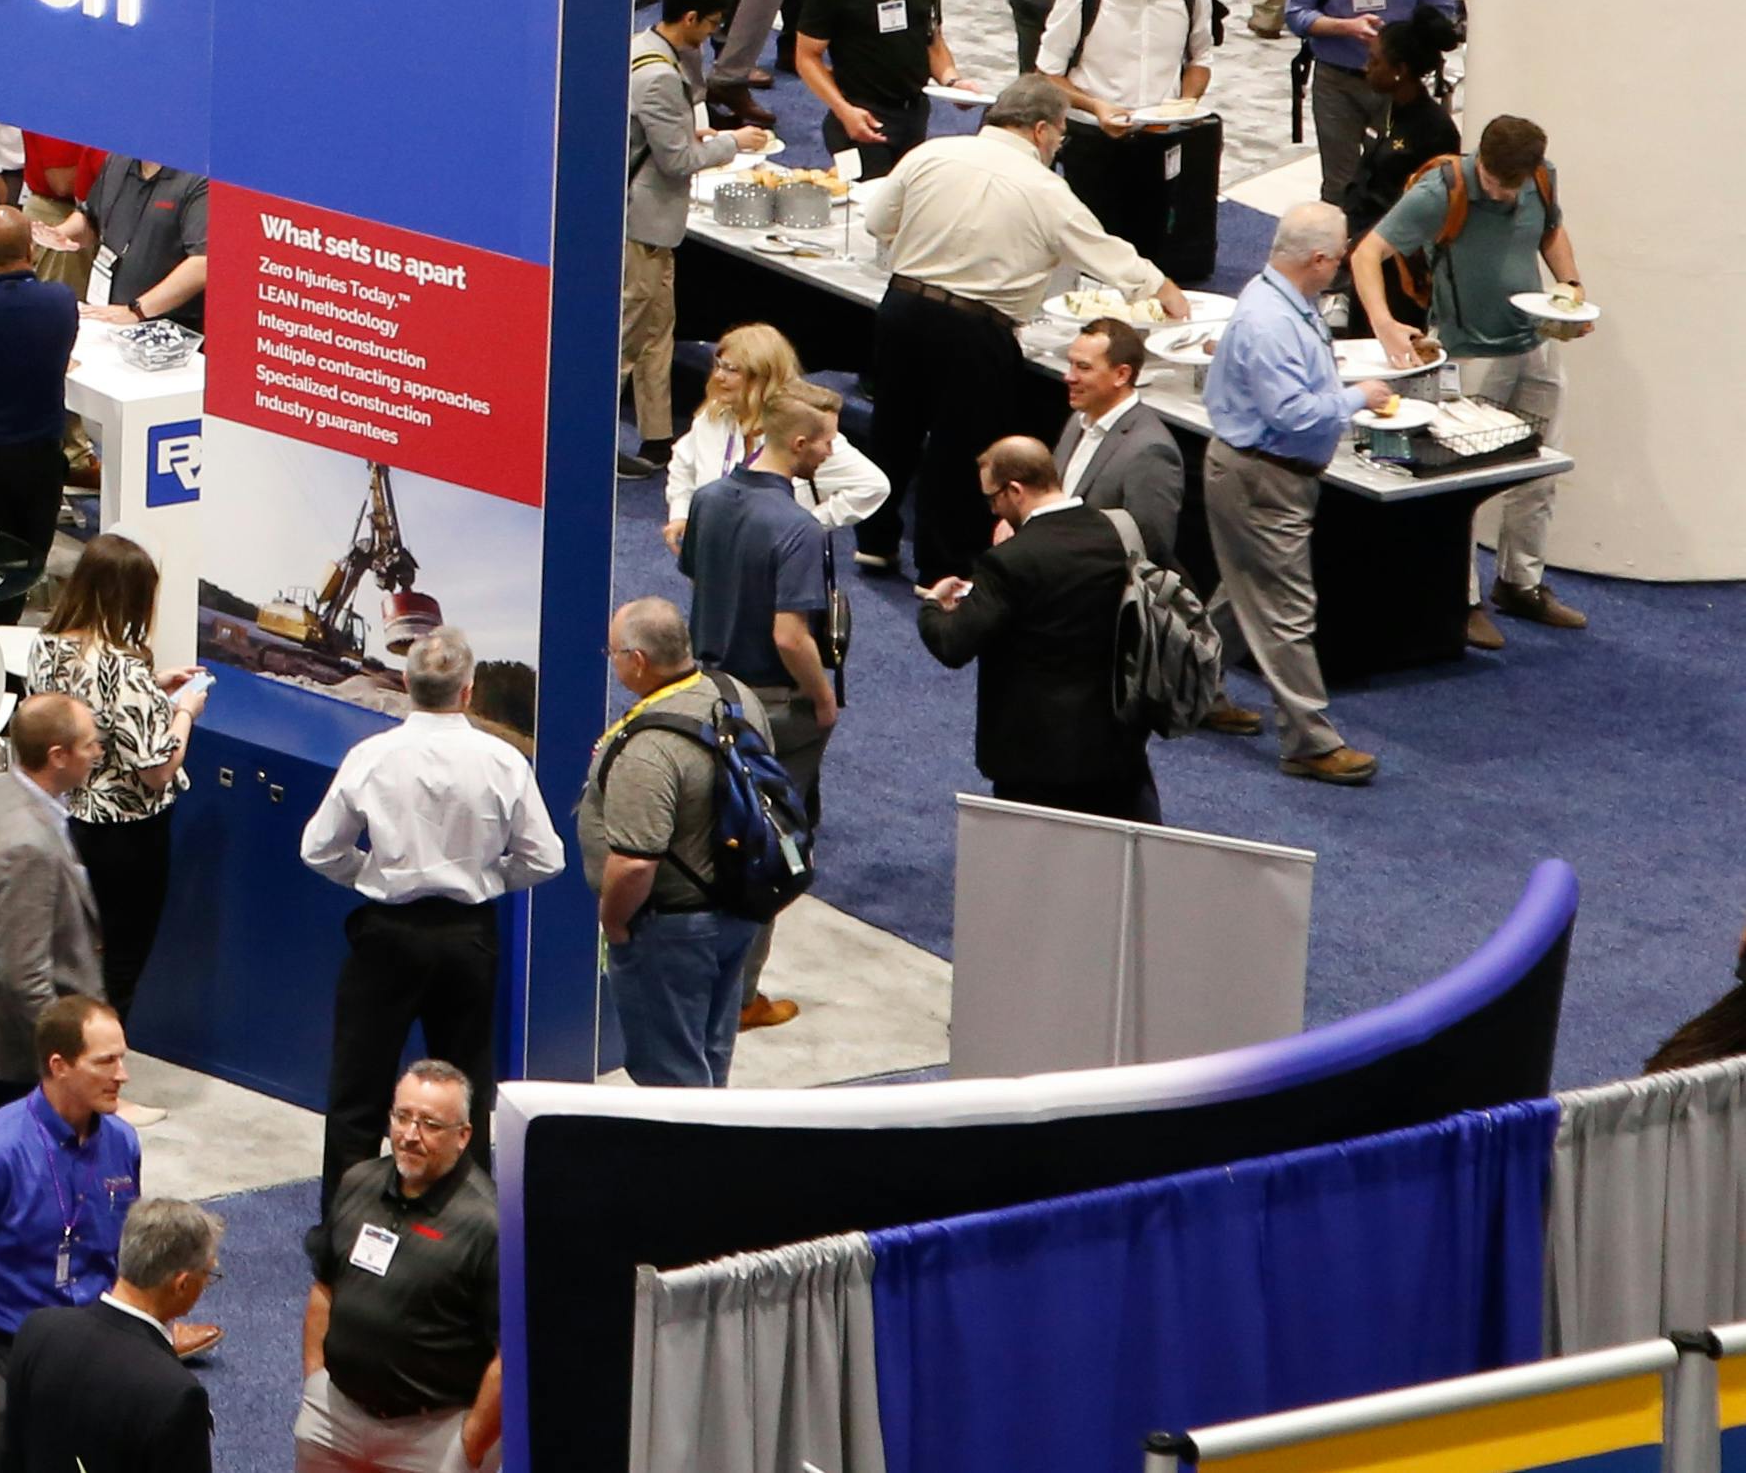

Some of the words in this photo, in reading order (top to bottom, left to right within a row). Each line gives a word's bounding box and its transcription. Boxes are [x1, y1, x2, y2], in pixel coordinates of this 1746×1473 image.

[259, 213, 322, 253] What
[324, 232, 372, 265] sets
[374, 250, 401, 272] us
[404, 256, 467, 290] apart
[259, 256, 293, 280] Zero
[295, 266, 347, 295] Injuries
[258, 310, 332, 345] Integrated
[335, 334, 426, 369] construction
[259, 284, 299, 308] LEAN
[301, 295, 399, 340] methodology
[256, 365, 338, 401] Specialized
[340, 390, 432, 426] construction
[257, 337, 316, 368] Multiple
[318, 355, 401, 394] contracting
[403, 378, 491, 416] approaches
[255, 391, 314, 424] Industry
[315, 410, 399, 445] guarantees
